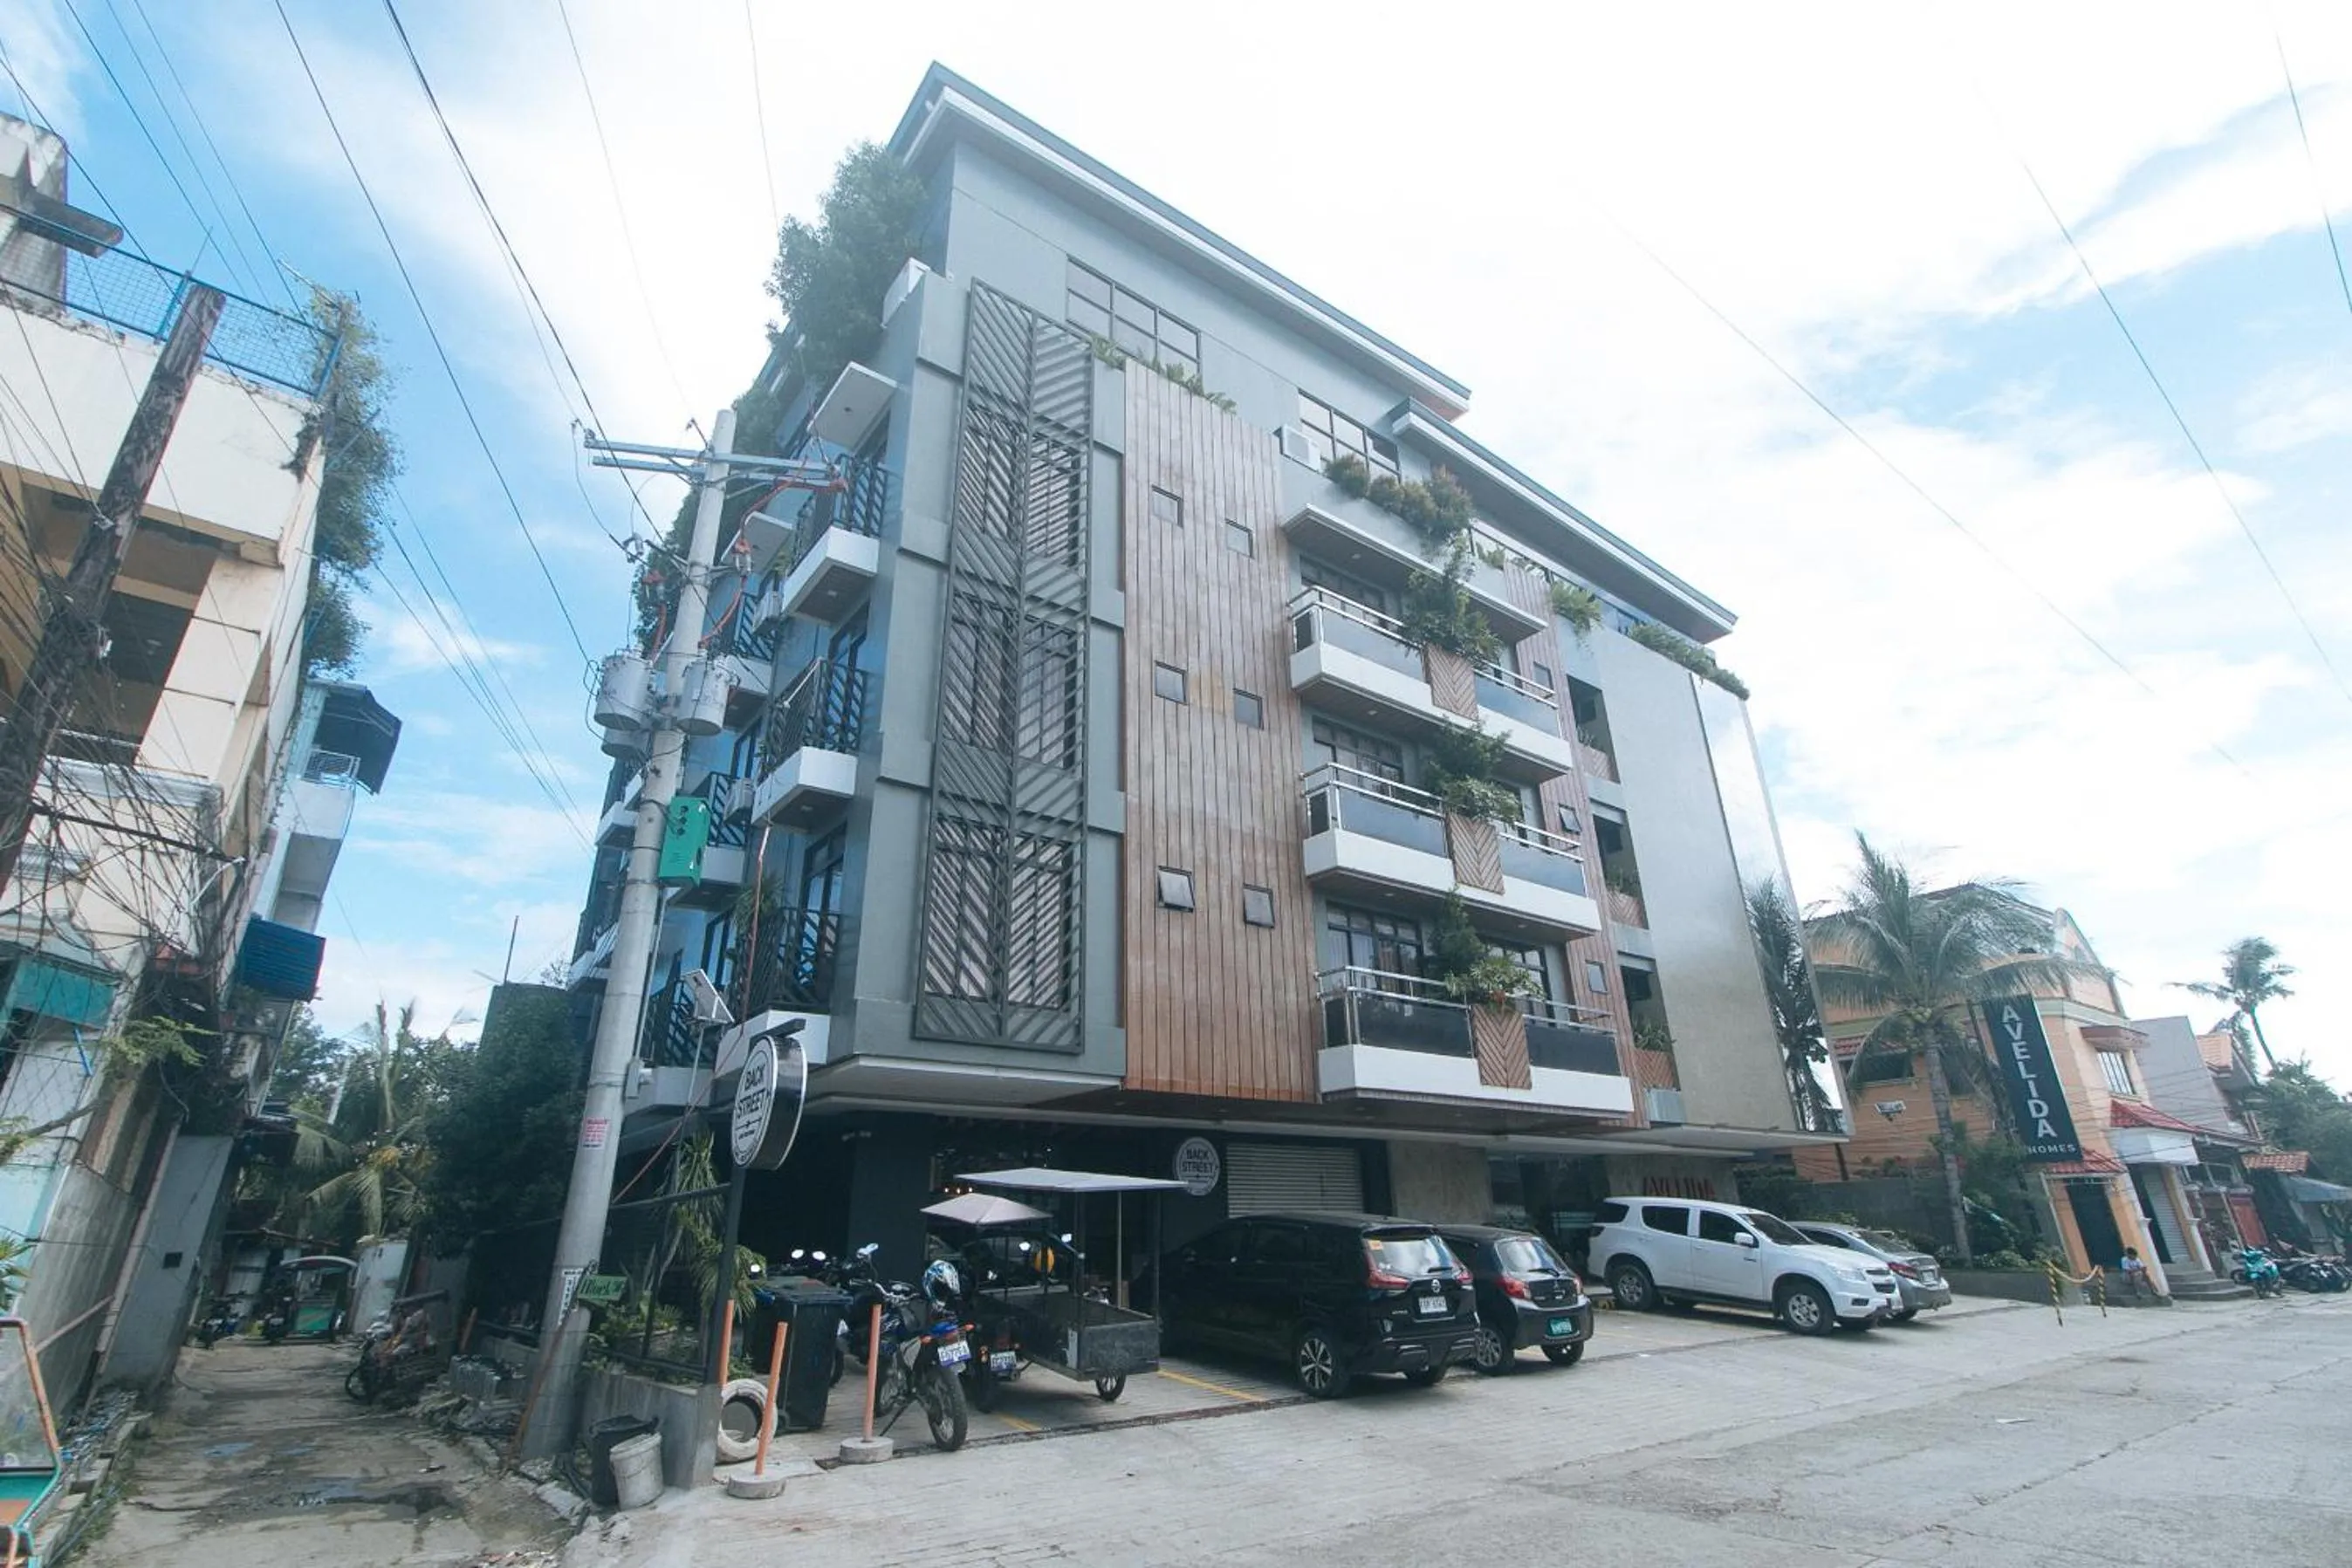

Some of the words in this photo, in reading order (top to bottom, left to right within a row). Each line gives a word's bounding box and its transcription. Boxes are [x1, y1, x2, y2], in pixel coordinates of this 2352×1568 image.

[744, 1063, 766, 1091] BACK
[2002, 1005, 2058, 1138] AVELIDA
[737, 1088, 766, 1120] STREET
[1186, 1147, 1209, 1160] BACK
[2028, 1143, 2076, 1154] HOMES
[1182, 1161, 1213, 1174] STREET
